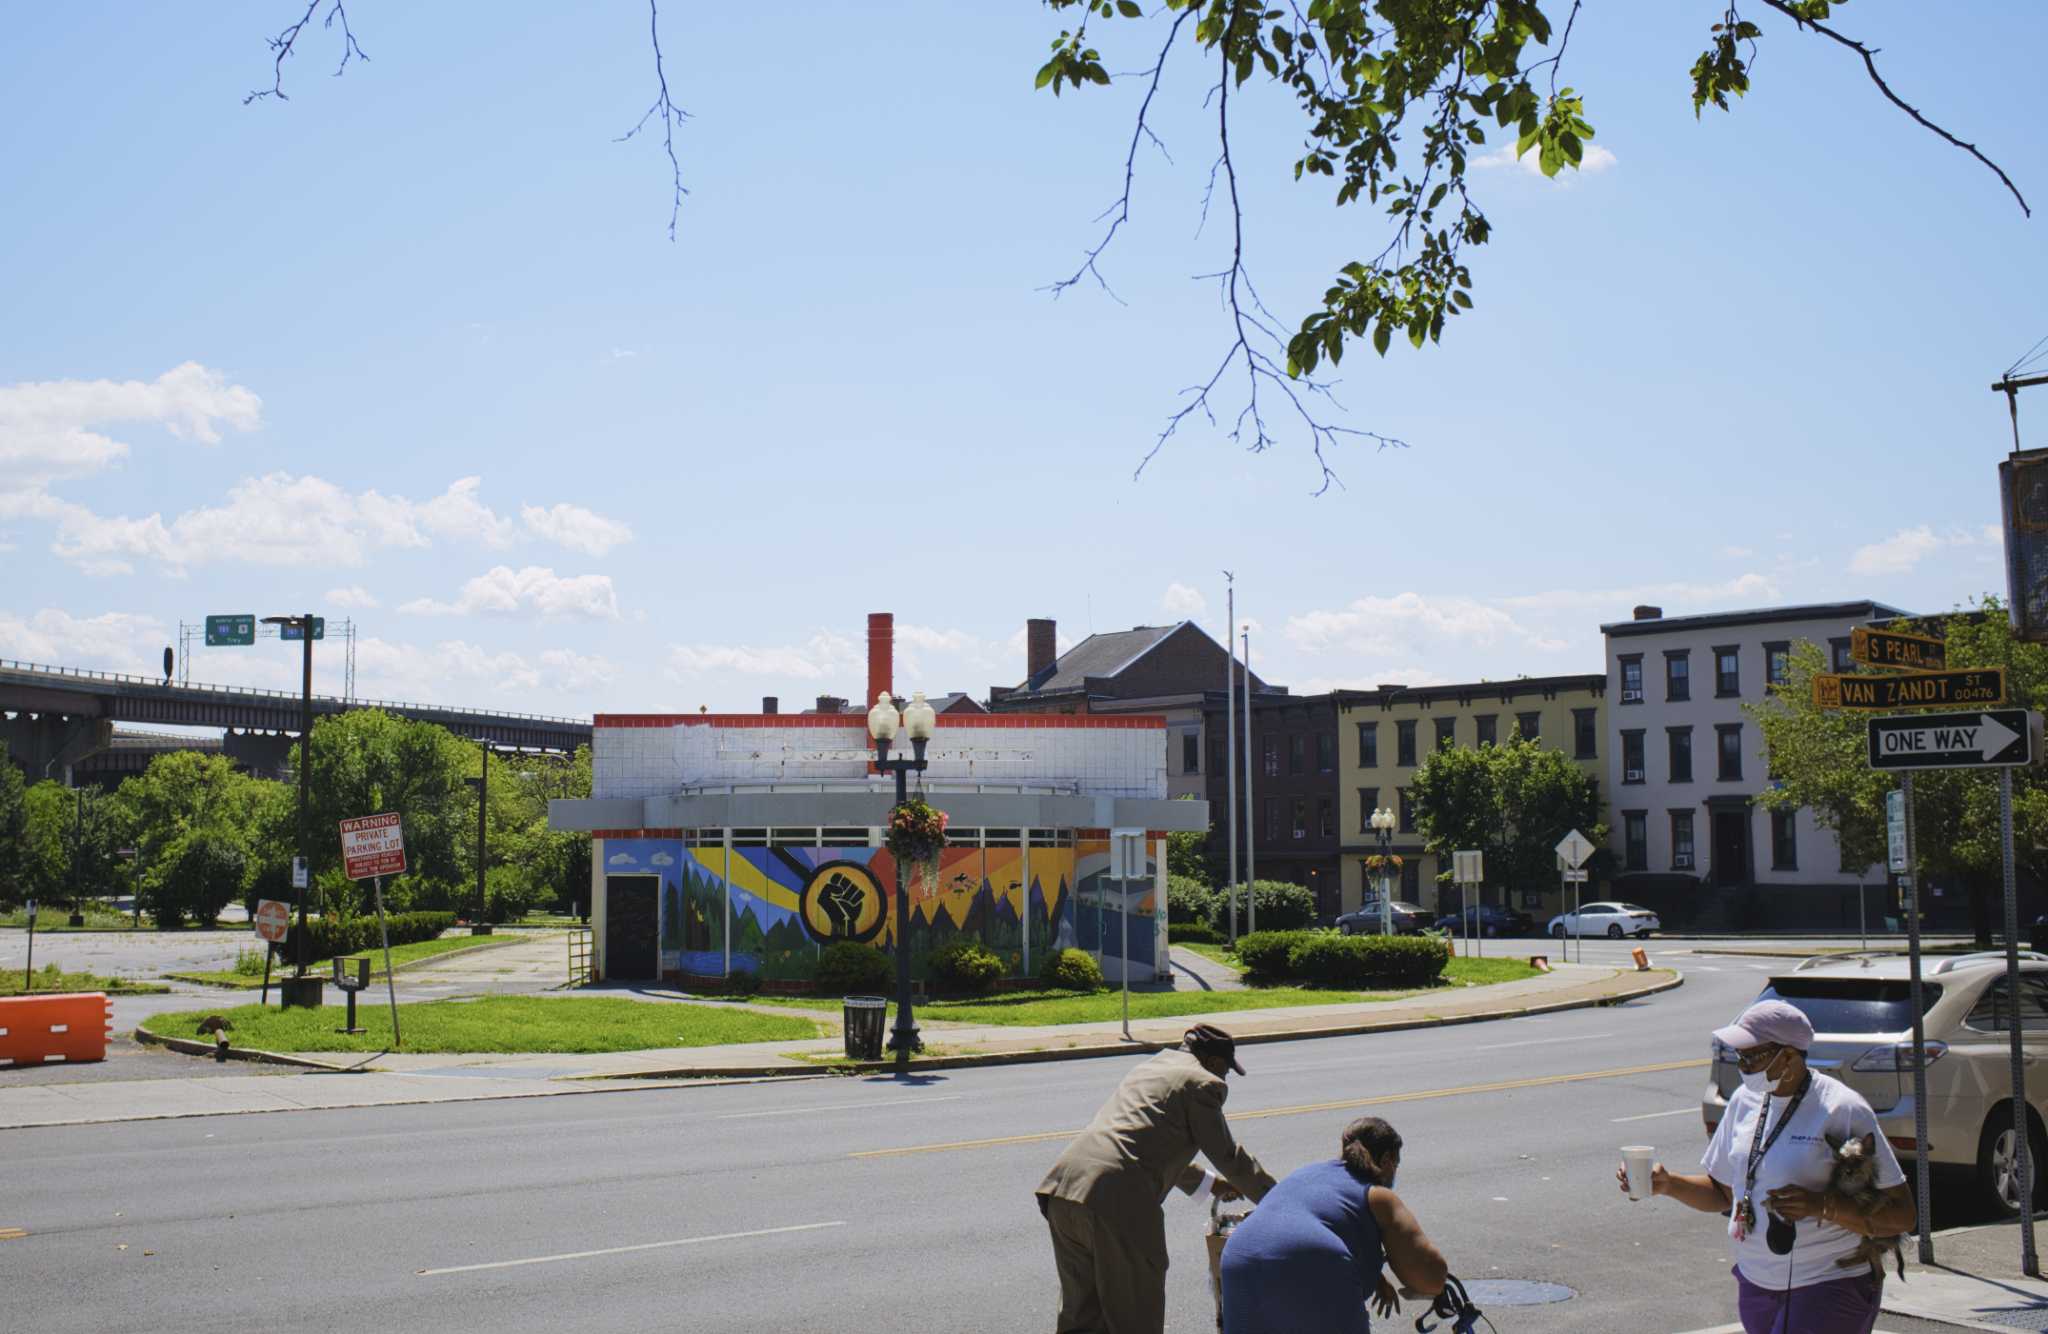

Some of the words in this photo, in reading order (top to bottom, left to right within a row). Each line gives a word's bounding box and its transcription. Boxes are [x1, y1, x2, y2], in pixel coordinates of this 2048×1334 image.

[1871, 639, 1879, 658] S
[1887, 641, 1924, 665] PEARL
[1965, 674, 1981, 686] ST
[1843, 681, 1875, 704] VAN
[1887, 679, 1950, 703] ZANDT
[1954, 687, 1994, 701] 00476
[1885, 731, 1926, 752] ONE
[1934, 728, 1978, 750] WAY
[343, 815, 398, 831] WARNING
[355, 829, 389, 842] PRIVATE
[346, 841, 382, 856] PARKING
[384, 838, 400, 850] LOT
